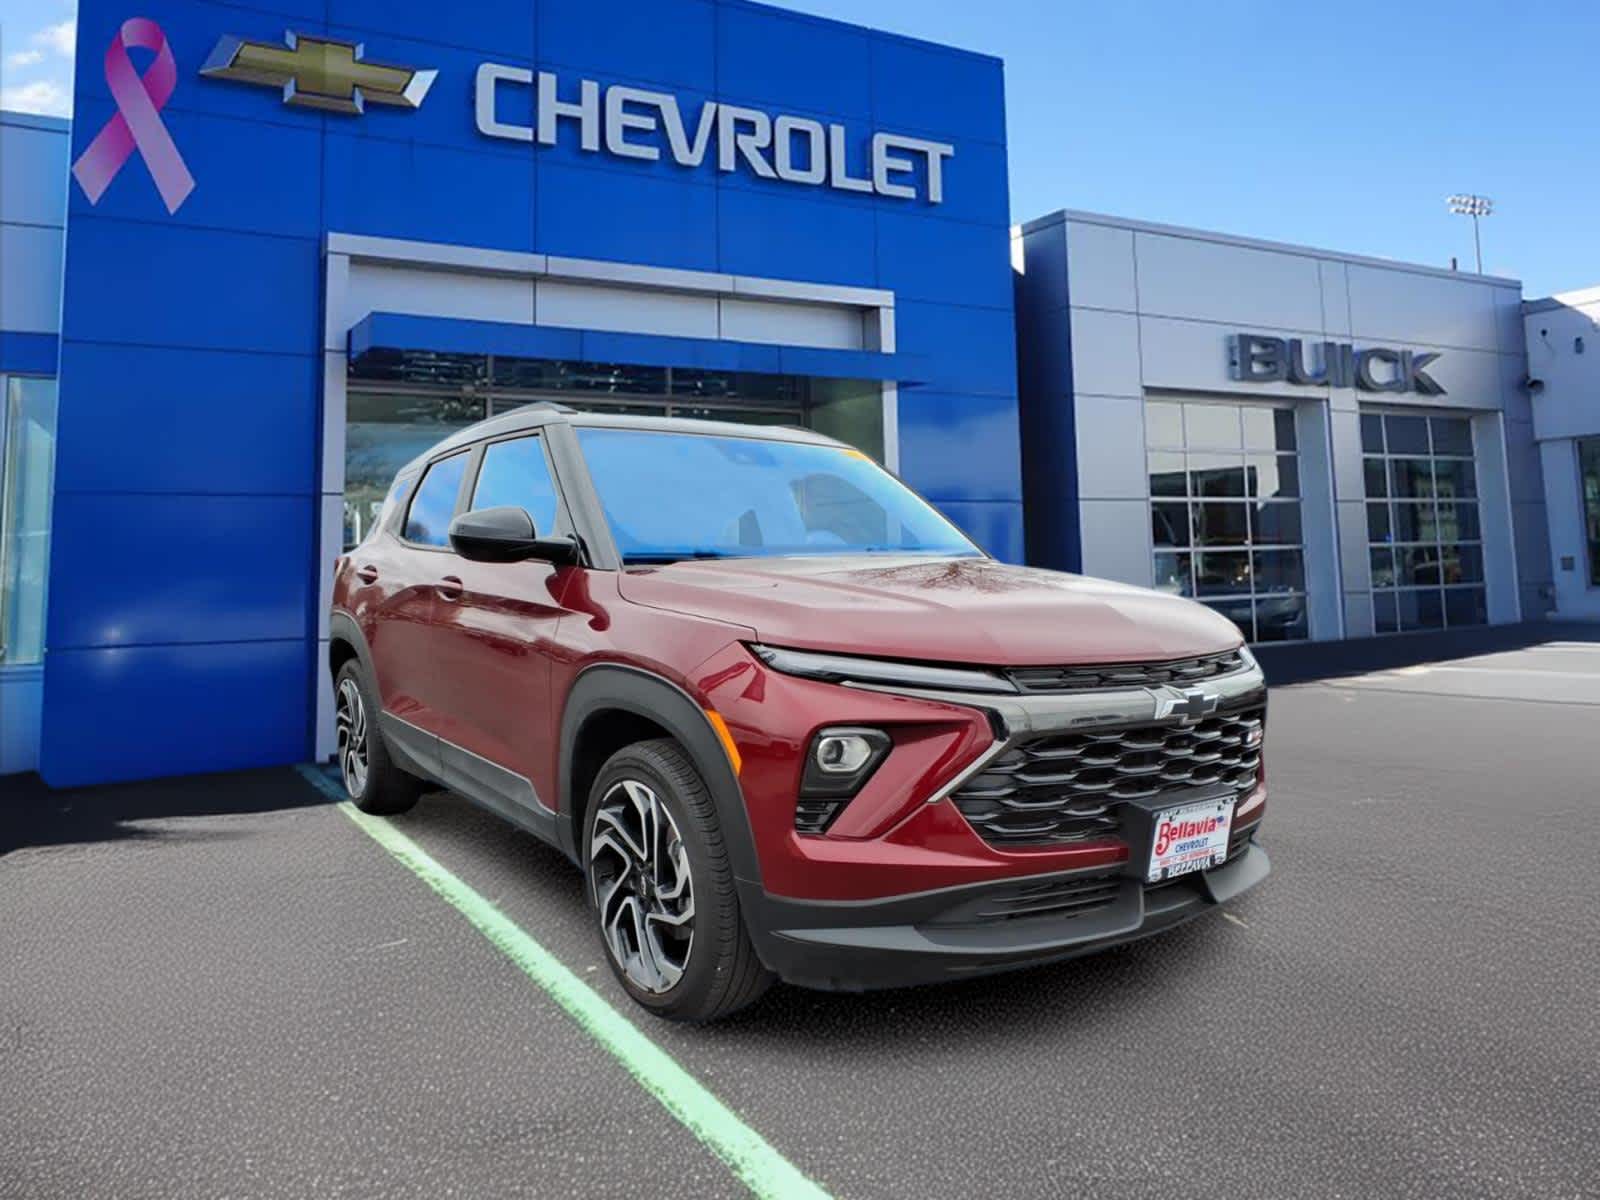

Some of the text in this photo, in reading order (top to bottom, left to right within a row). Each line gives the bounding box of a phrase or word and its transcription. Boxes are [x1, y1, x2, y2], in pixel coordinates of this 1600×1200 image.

[474, 61, 956, 205] CHEVROLET
[1229, 333, 1448, 396] BUICK
[1155, 815, 1218, 856] Bellavia
[1175, 837, 1209, 854] CHEVROLET
